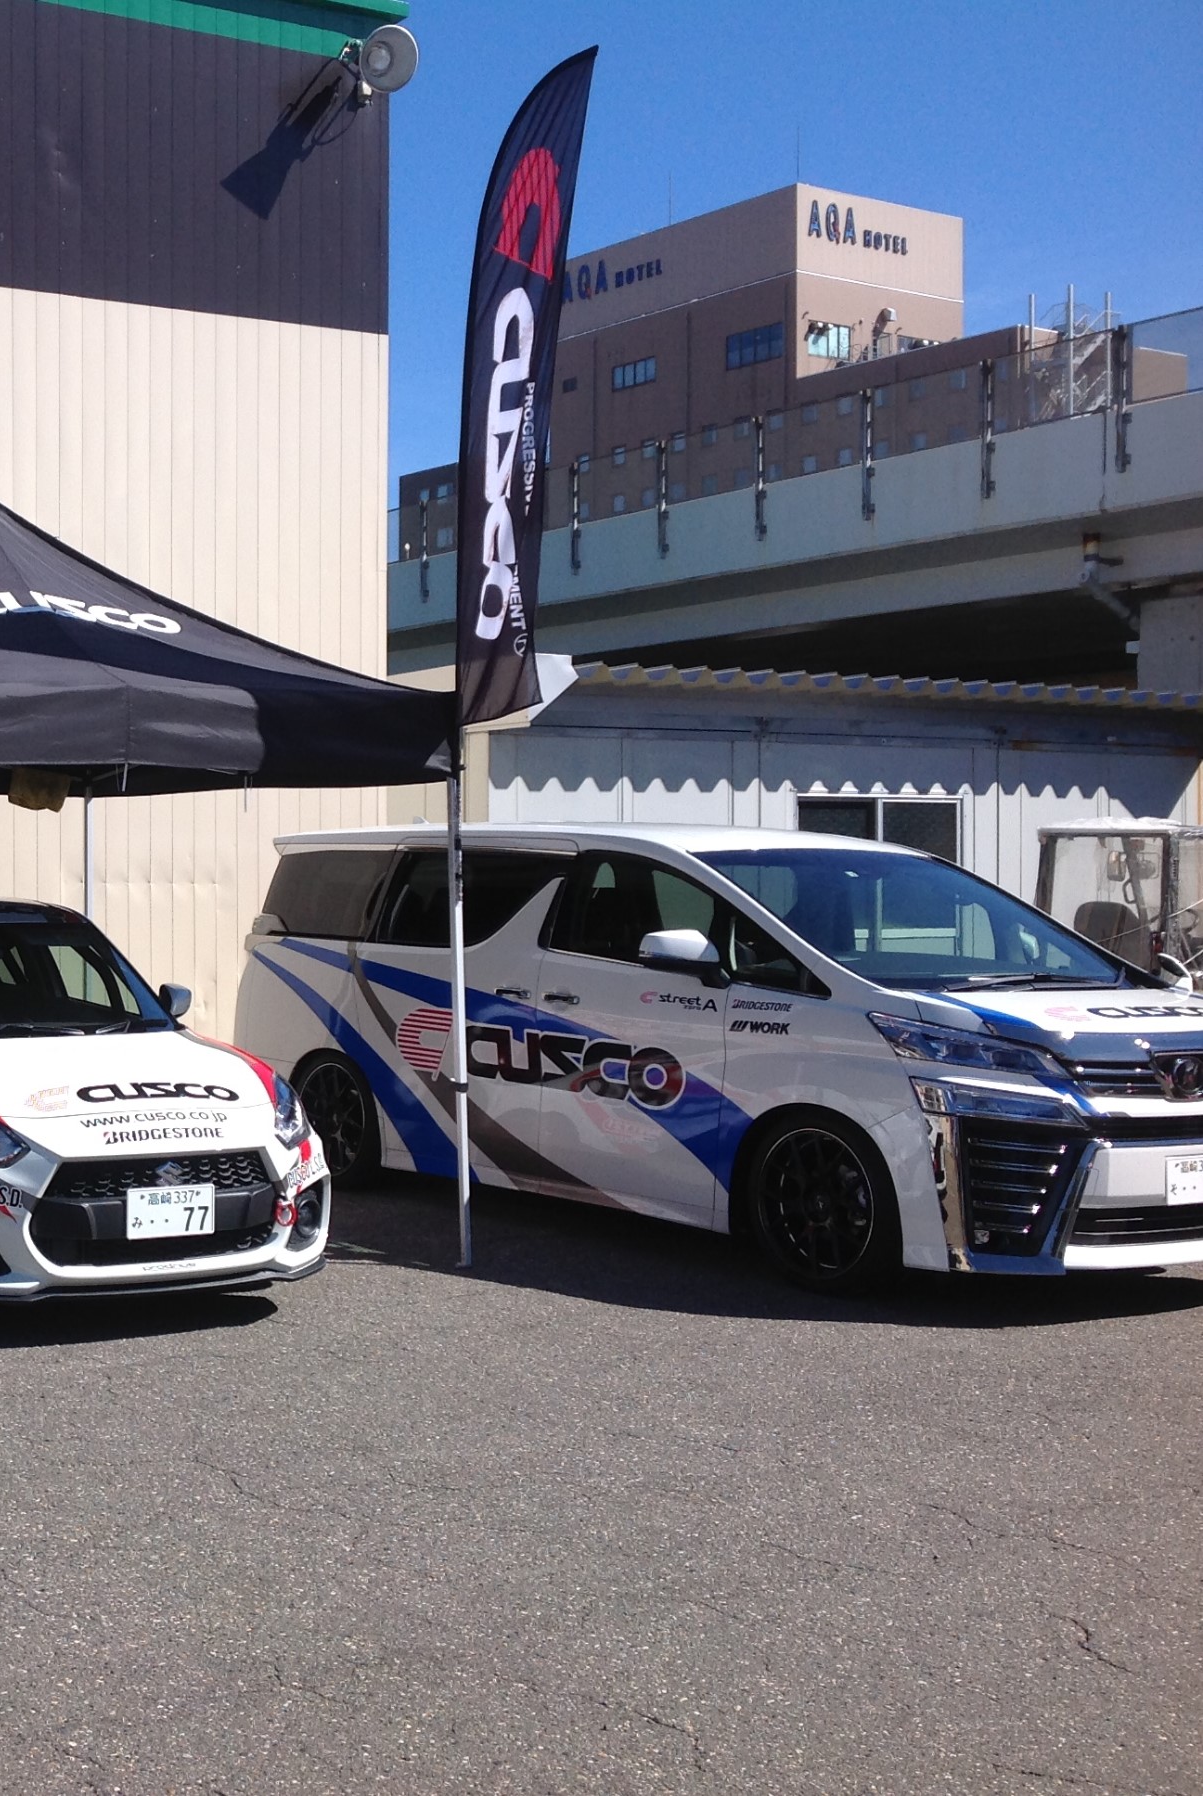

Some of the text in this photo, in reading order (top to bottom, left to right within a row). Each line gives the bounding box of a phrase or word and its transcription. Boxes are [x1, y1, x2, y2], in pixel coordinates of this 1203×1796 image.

[808, 199, 908, 256] AQA HOTEL
[562, 258, 662, 304] AQA HOTEL
[521, 382, 537, 517] PROGRESSIV
[658, 993, 717, 1012] street A
[732, 999, 793, 1012] BRIDGESTONE
[748, 1021, 791, 1035] WORK
[466, 1023, 686, 1109] CUSCO
[76, 1082, 239, 1103] CUSCO
[80, 1110, 227, 1128] www.cusco.co.jp
[103, 1127, 224, 1145] BRIDGESTONE
[148, 1189, 195, 1205] 高崎 337
[131, 1216, 143, 1229] み
